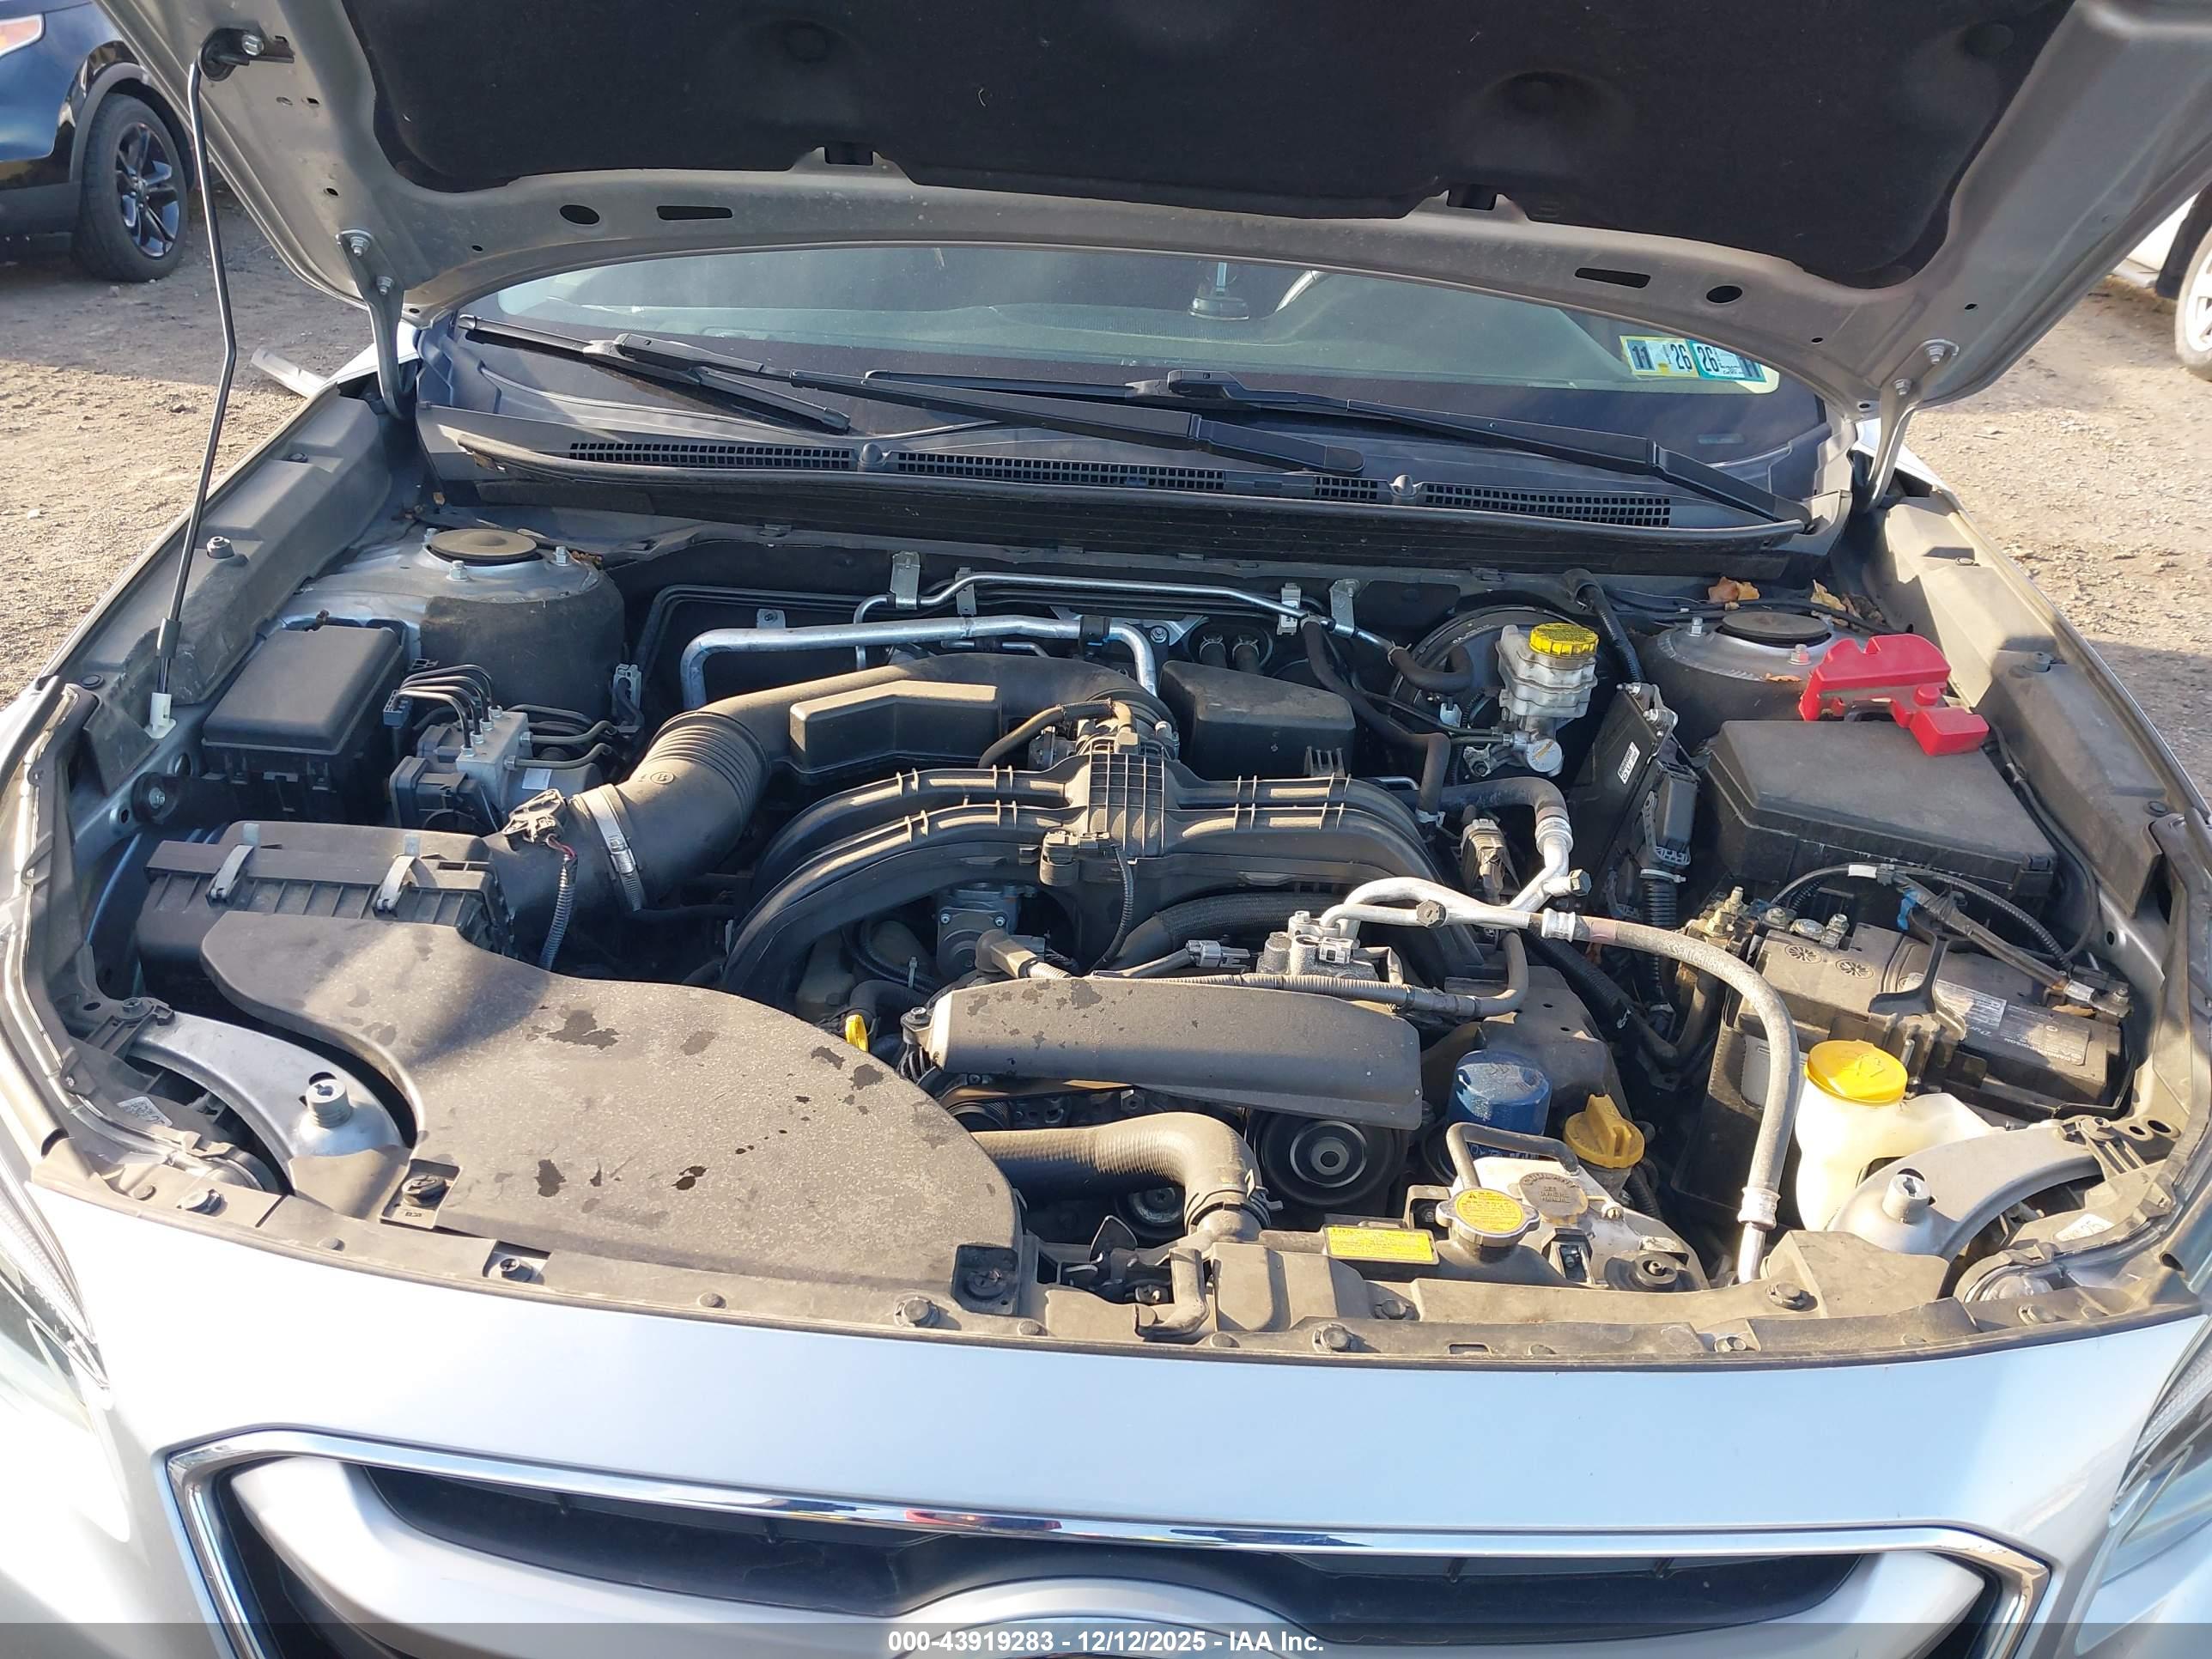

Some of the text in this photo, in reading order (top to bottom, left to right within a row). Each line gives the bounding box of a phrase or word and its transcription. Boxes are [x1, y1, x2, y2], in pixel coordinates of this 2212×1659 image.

[1632, 344, 1692, 369] 11 26
[1697, 346, 1719, 372] 26
